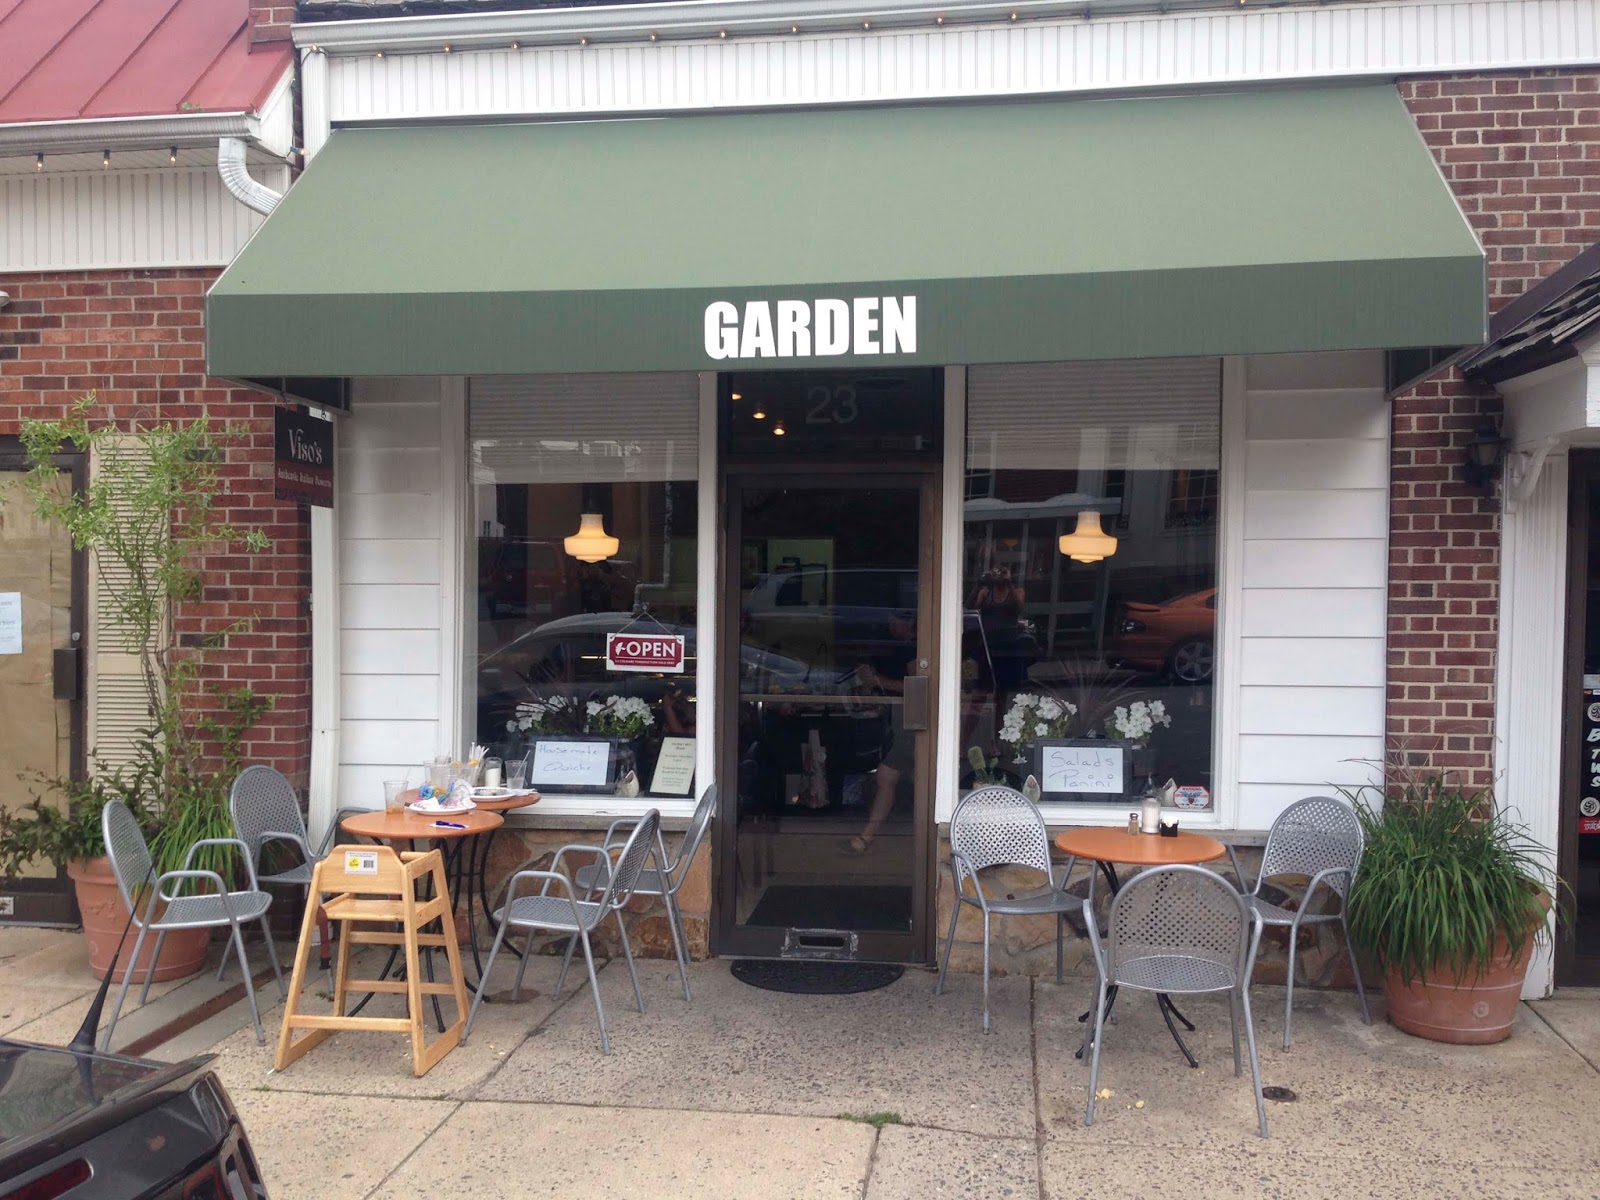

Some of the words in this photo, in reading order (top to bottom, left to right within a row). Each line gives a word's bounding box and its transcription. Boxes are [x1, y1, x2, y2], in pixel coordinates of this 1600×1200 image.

[704, 295, 917, 360] GARDEN
[805, 385, 858, 424] 23
[288, 428, 323, 465] Viso's
[626, 641, 675, 657] OPEN
[1050, 751, 1115, 768] Salads
[1048, 768, 1115, 788] Panini
